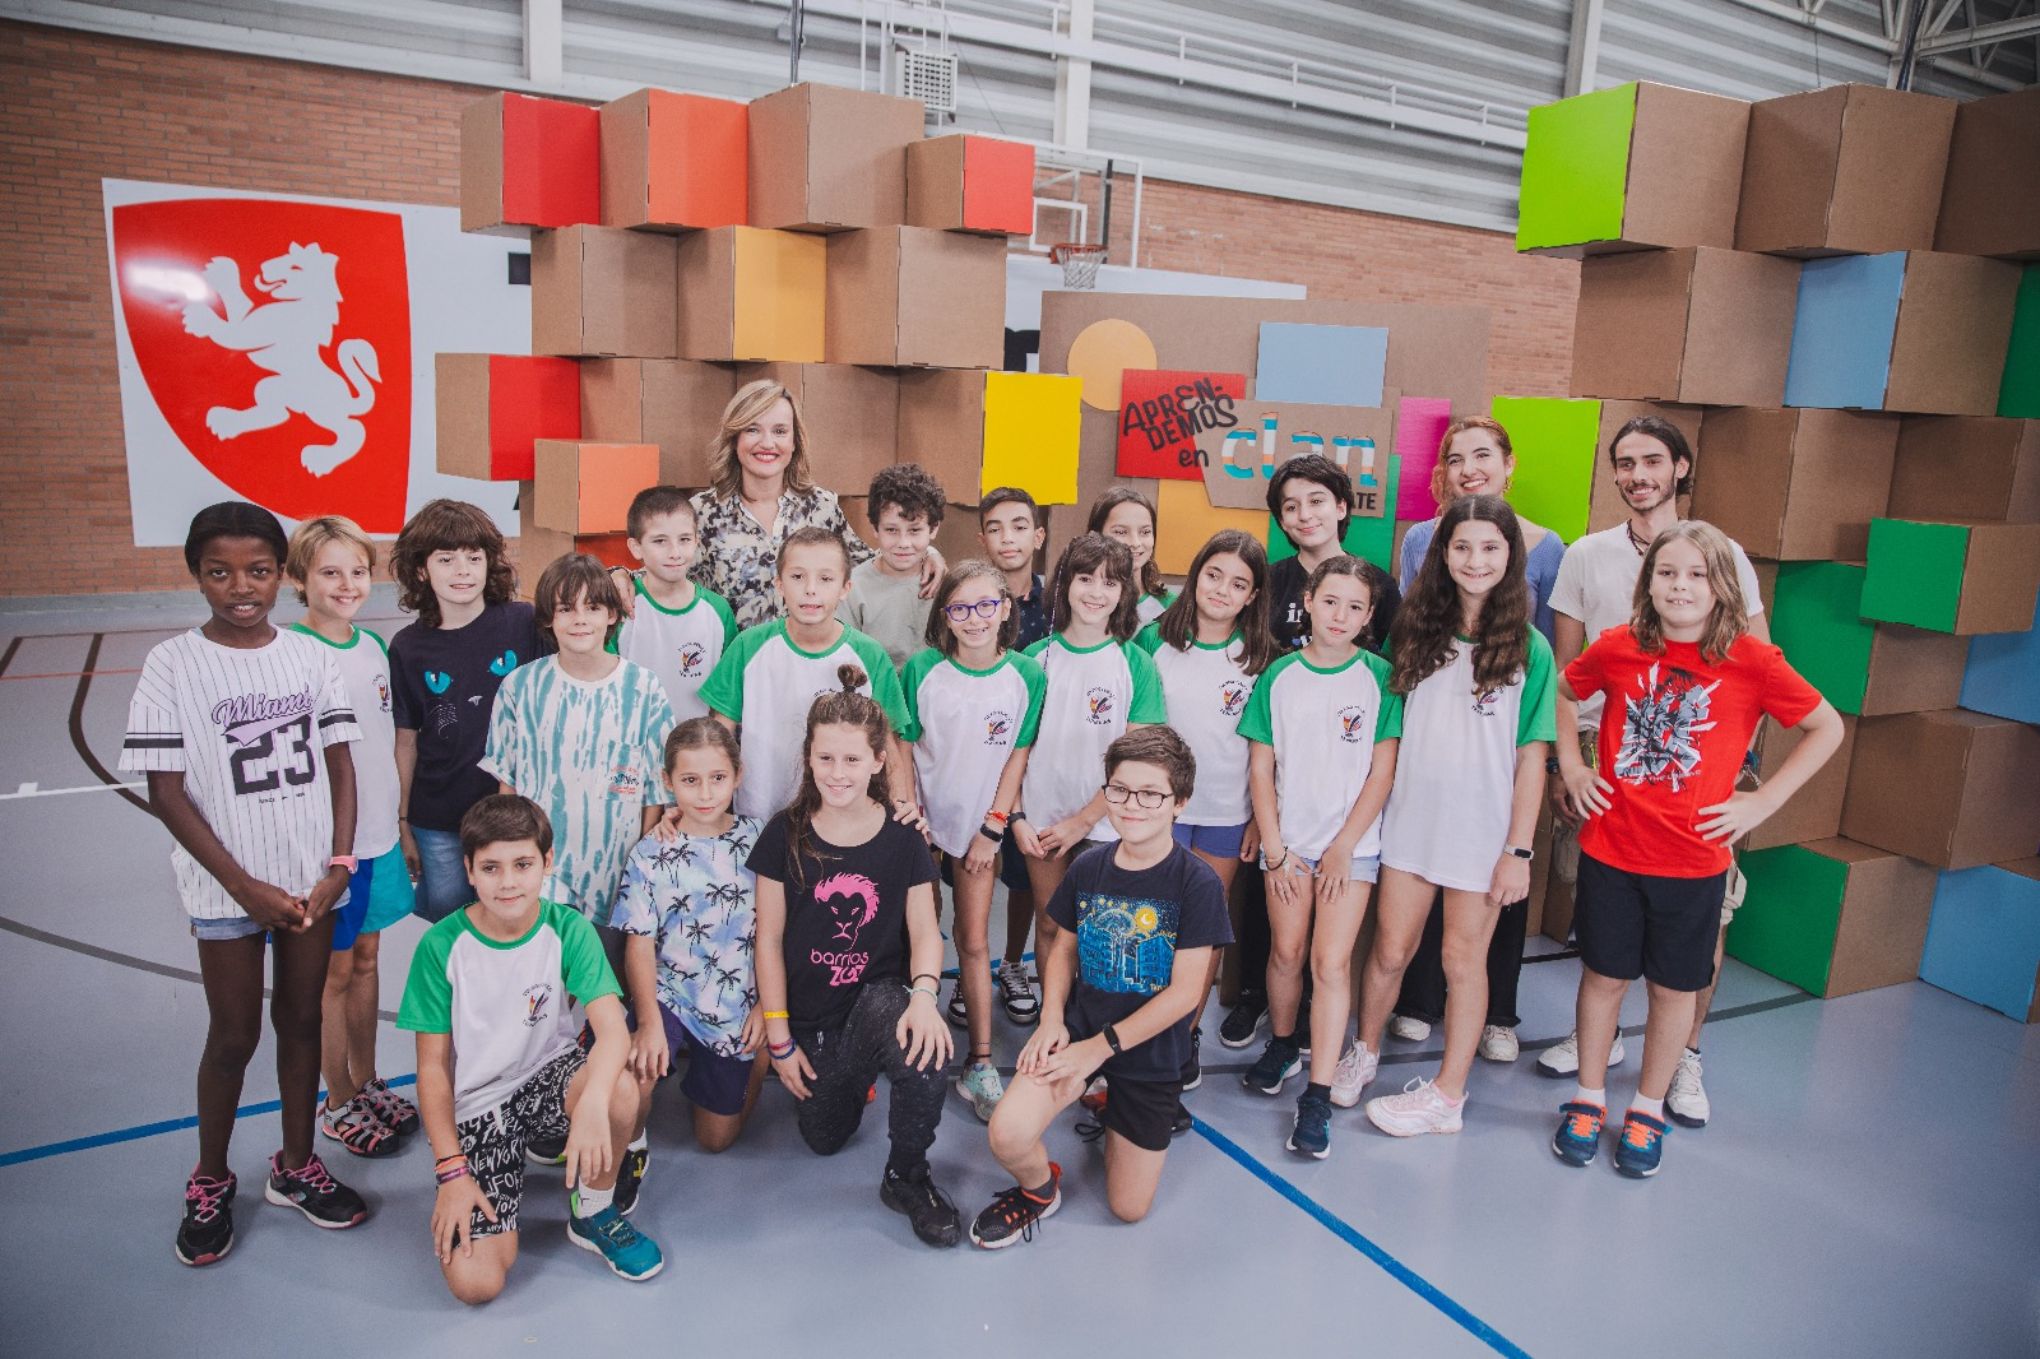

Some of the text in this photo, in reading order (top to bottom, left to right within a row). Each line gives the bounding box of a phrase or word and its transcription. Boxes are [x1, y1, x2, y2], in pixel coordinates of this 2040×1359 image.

[1144, 394, 1239, 452] DEMOS
[1178, 448, 1210, 468] en
[211, 681, 313, 728] Miami
[225, 713, 316, 796] 23
[811, 948, 869, 966] barrios
